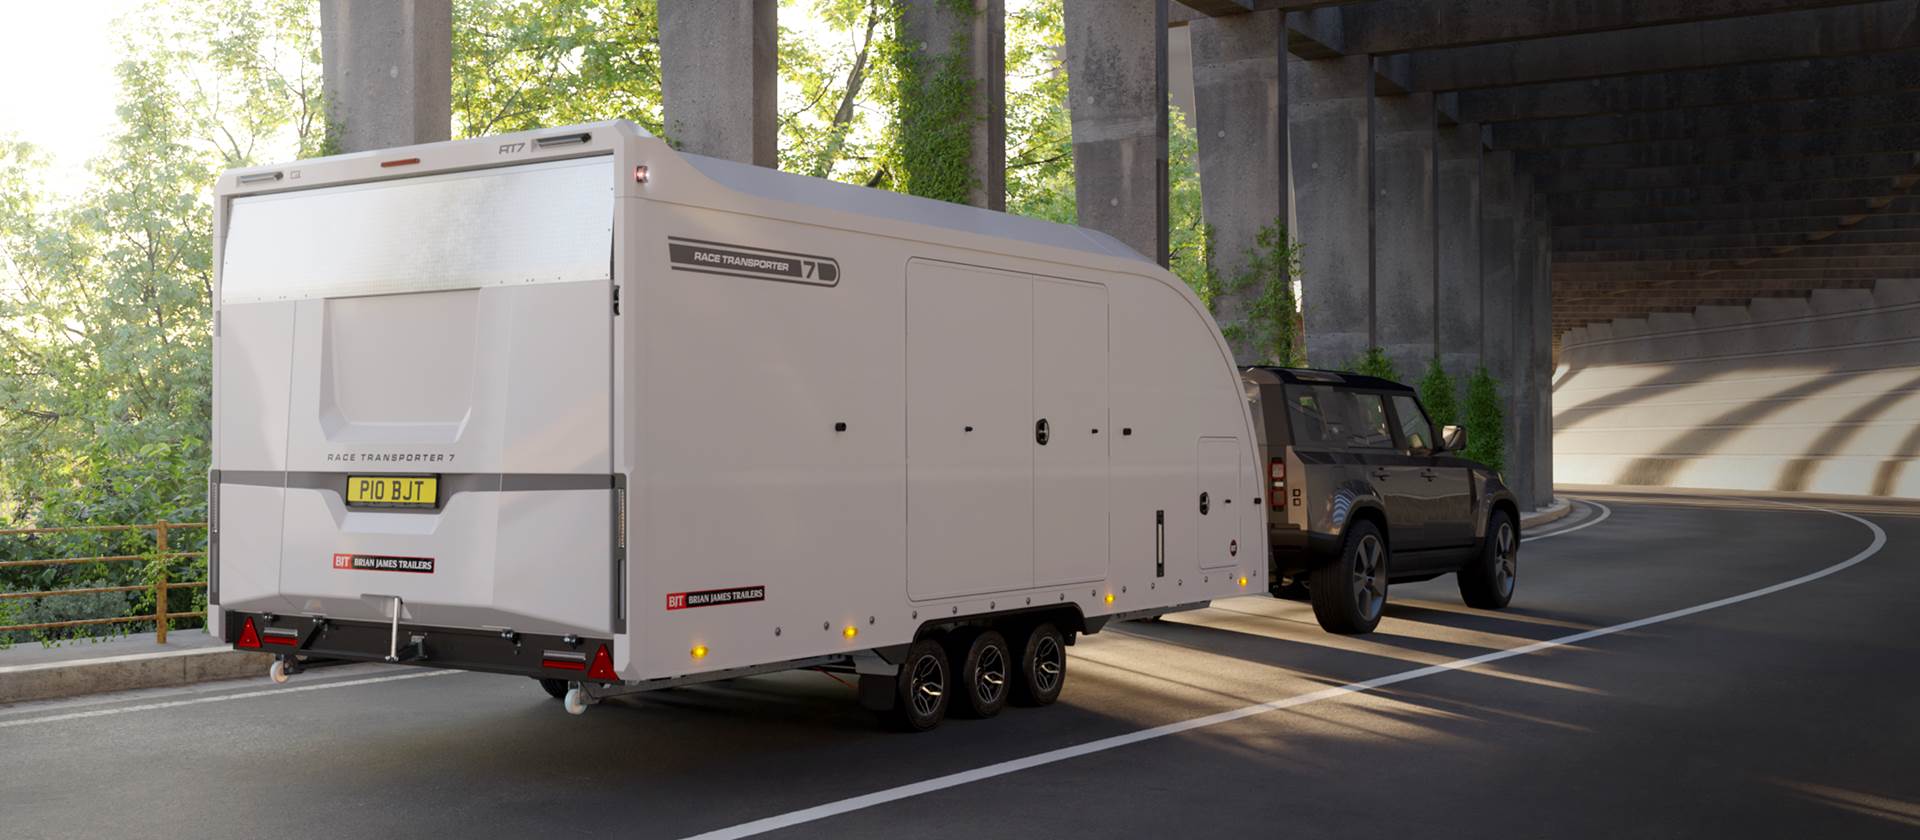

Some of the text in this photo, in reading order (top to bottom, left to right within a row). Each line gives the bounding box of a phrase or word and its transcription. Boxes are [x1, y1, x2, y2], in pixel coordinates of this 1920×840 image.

[694, 252, 816, 279] RACE TRANSPORTER 7
[327, 453, 356, 461] RACE
[361, 453, 444, 461] TRANSPORTER
[391, 480, 424, 500] BJT
[354, 558, 375, 567] BRIAN
[375, 559, 398, 568] JAMES
[398, 560, 433, 570] TRAILERS
[688, 593, 710, 604] BRIAN
[710, 592, 731, 603] JAMES
[732, 589, 763, 601] TRAILERS
